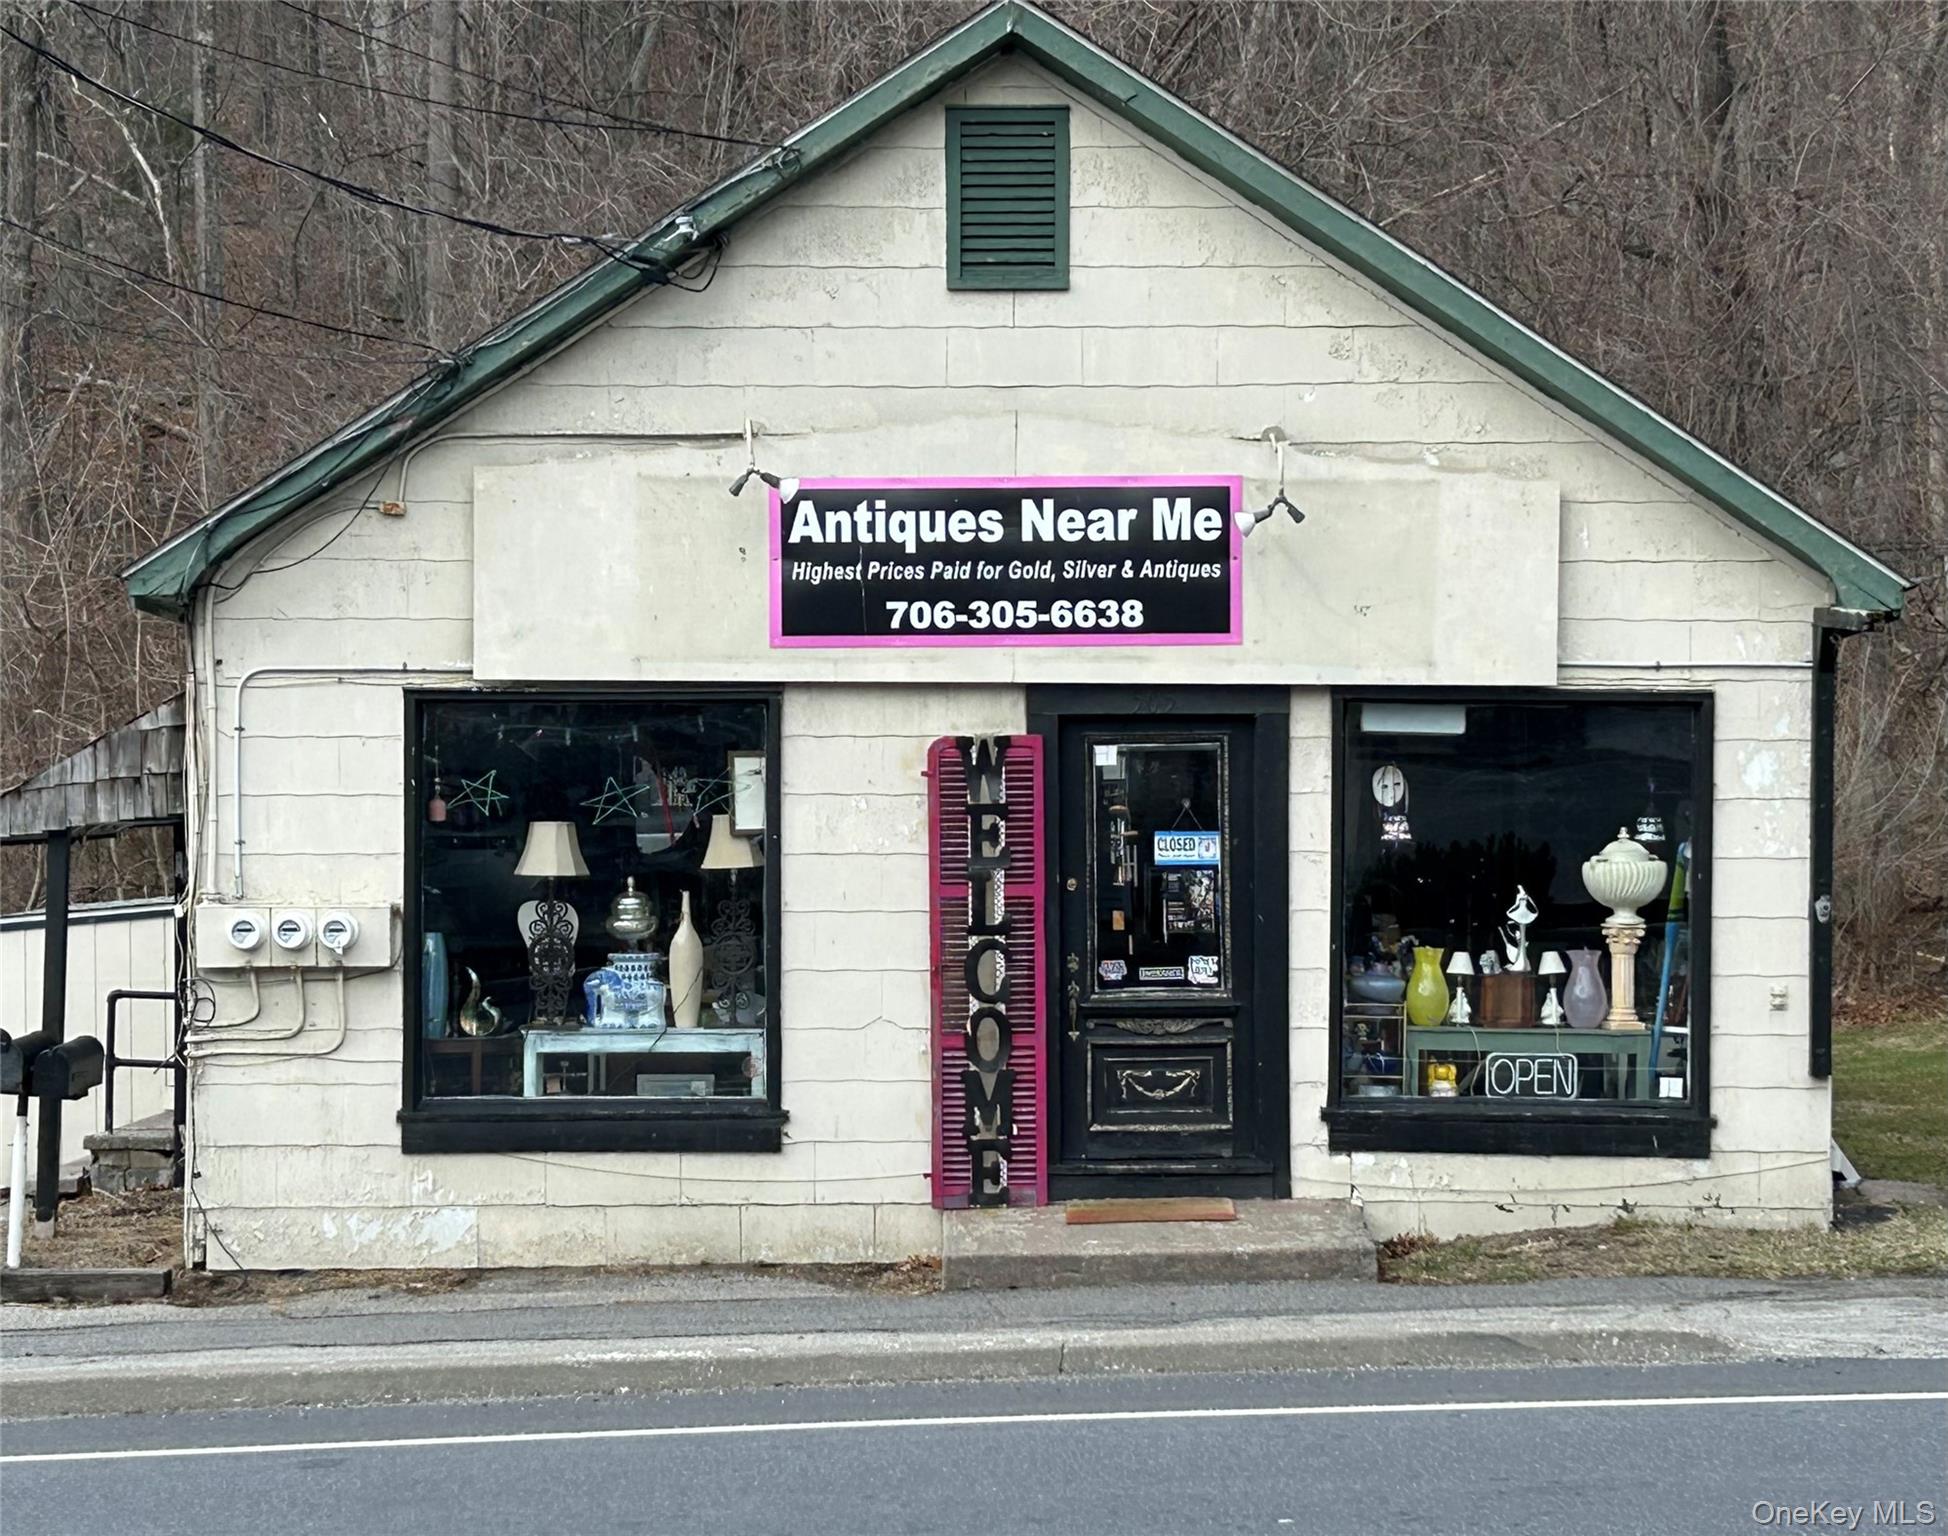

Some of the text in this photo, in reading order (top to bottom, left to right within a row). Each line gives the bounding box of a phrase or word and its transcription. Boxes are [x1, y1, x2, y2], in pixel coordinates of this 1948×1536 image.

[788, 497, 1222, 553] Antiques Near Me
[791, 559, 1222, 585] Highest Prices Paid for Gold, Silver & Antiques
[885, 599, 1145, 630] 706-305-6638
[1157, 836, 1196, 852] CLOSED
[955, 735, 1017, 1207] WELCOME
[1491, 1058, 1573, 1095] OPEN
